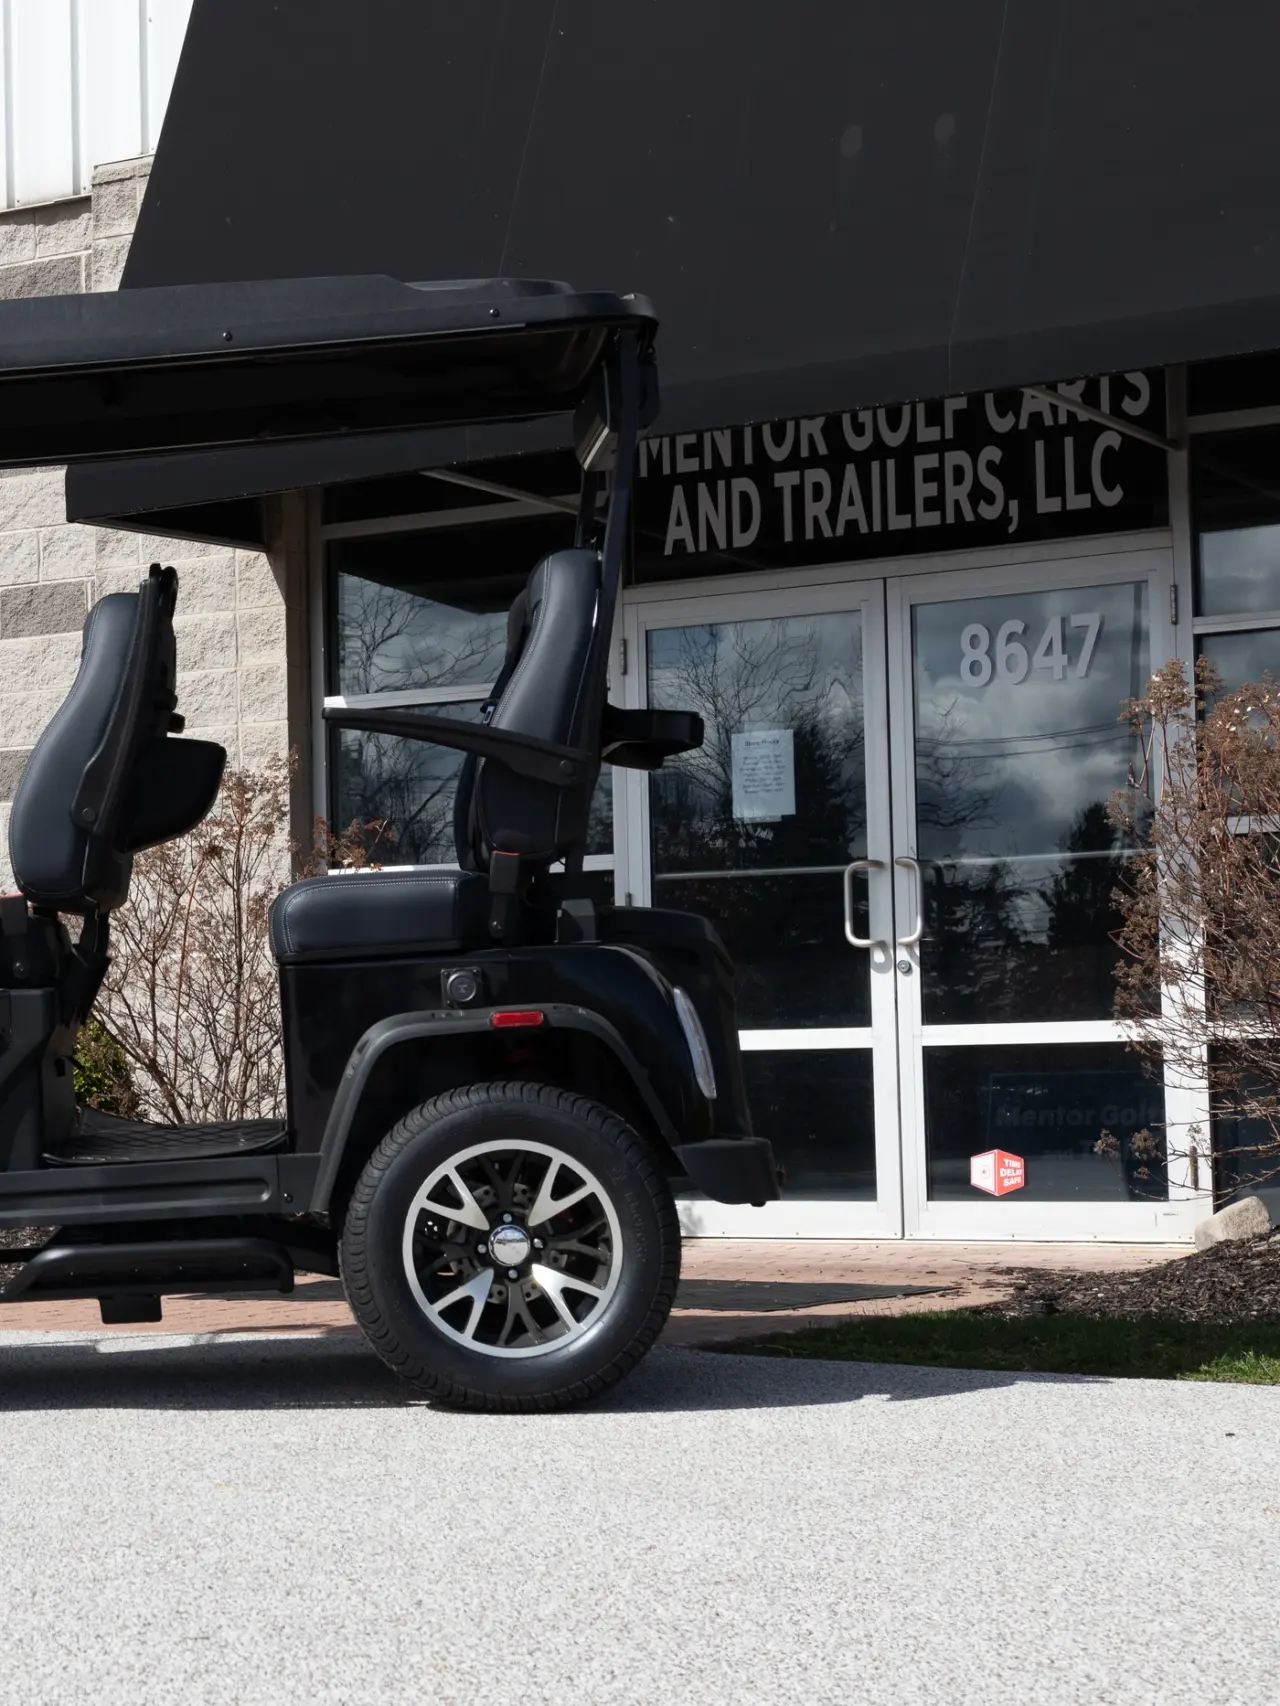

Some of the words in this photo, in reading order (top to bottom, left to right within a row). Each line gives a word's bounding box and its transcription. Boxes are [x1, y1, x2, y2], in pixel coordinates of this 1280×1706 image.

[842, 396, 968, 452] GOLF
[663, 476, 762, 556] AND
[774, 444, 1019, 543] TRAILERS,
[1034, 430, 1125, 514] LLC
[959, 612, 1106, 688] 8647
[994, 1104, 1096, 1127] Mentor
[999, 1168, 1023, 1177] DELAY
[1003, 1177, 1022, 1187] SAFE
